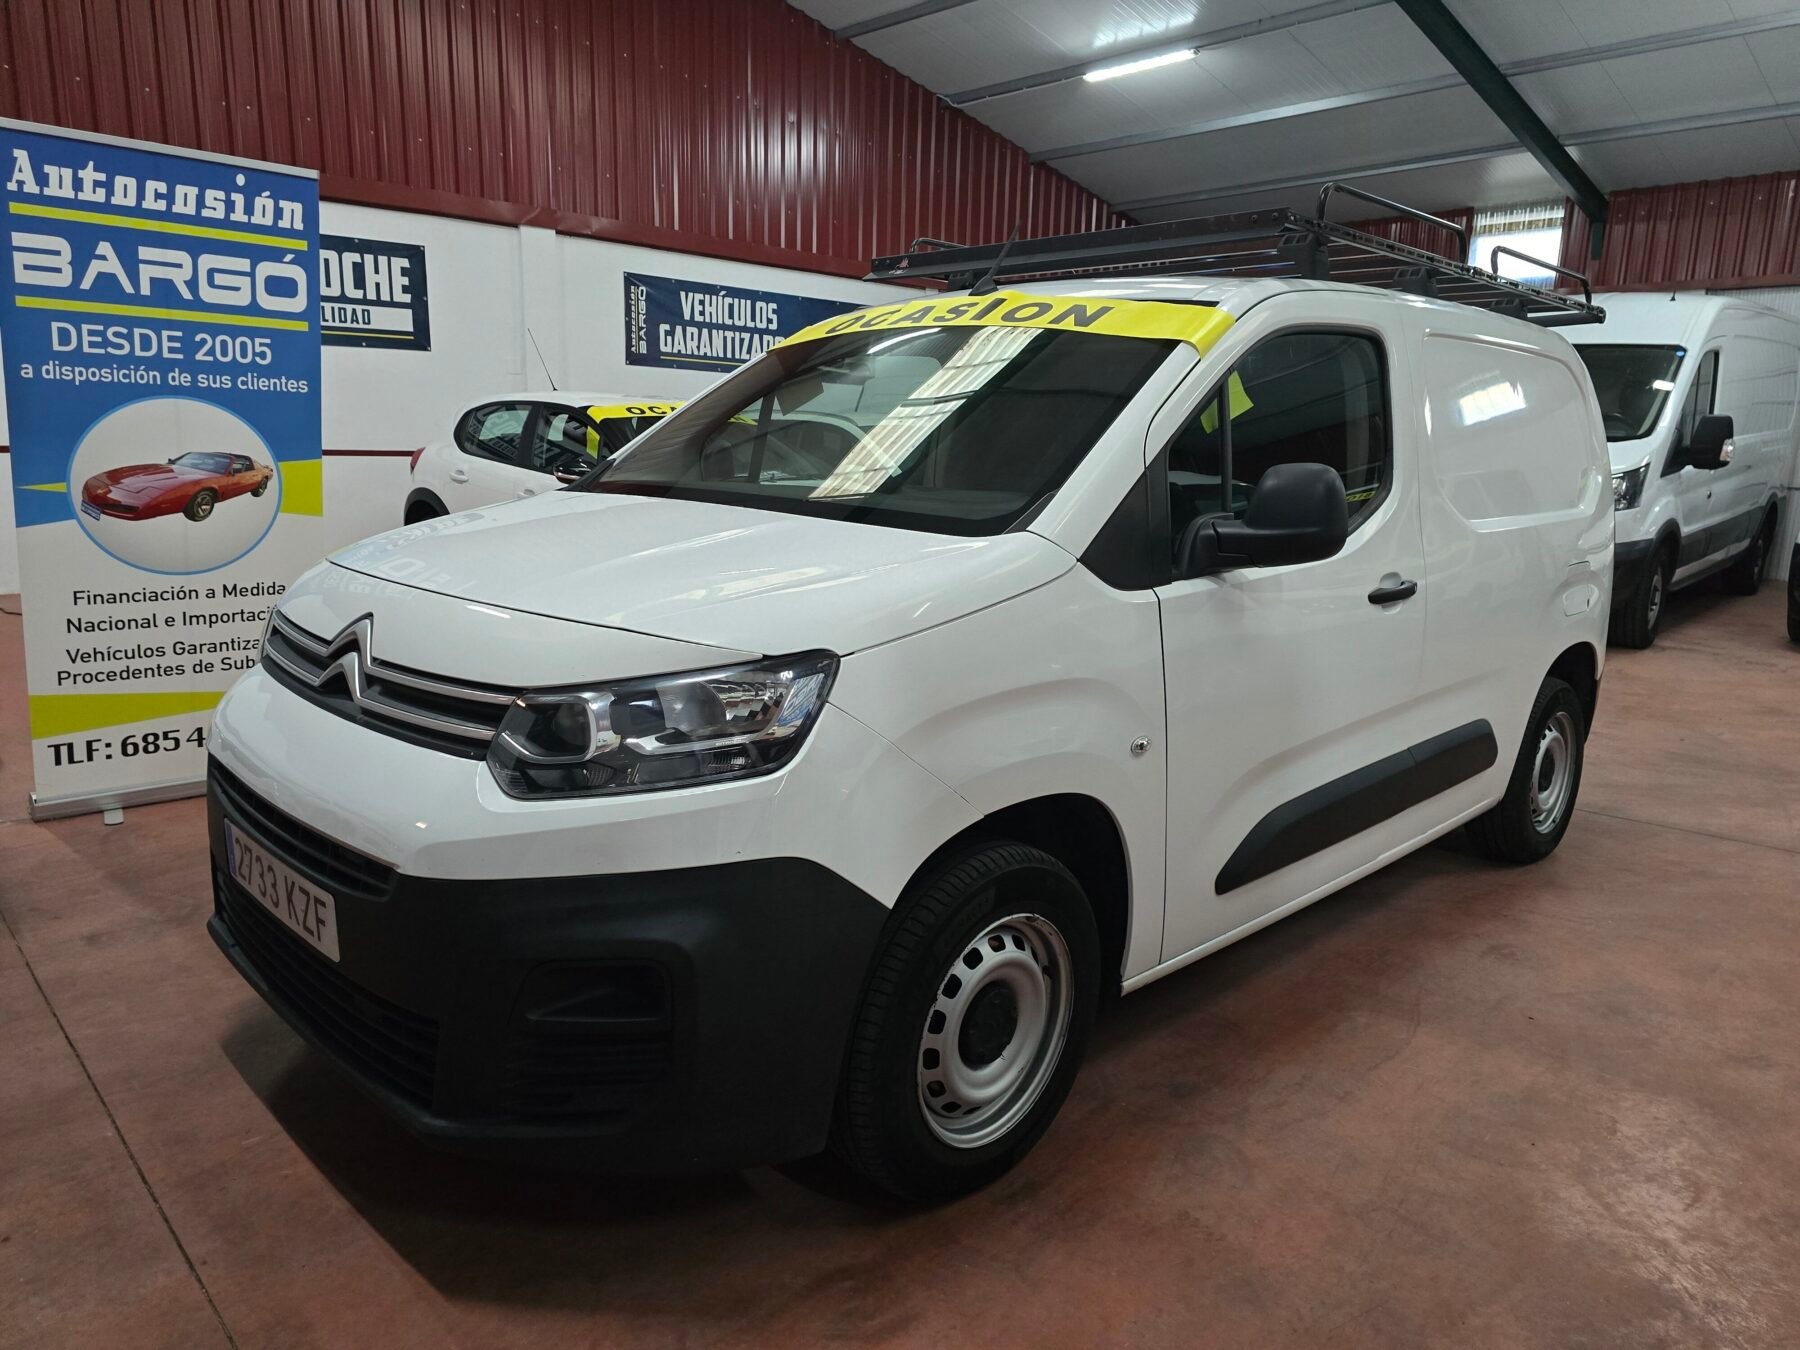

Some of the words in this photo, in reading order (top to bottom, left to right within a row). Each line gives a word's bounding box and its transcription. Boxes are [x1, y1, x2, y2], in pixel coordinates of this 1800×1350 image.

[7, 148, 303, 231] Autocasión
[11, 232, 308, 313] BARGÓ
[679, 291, 778, 330] VEHÍCULOS
[825, 297, 1115, 336] OCASION
[51, 321, 184, 359] DESDE
[194, 333, 272, 365] 2005
[20, 363, 33, 378] a
[41, 360, 161, 386] disposición
[168, 368, 191, 386] de
[198, 373, 232, 389] sus
[237, 372, 309, 393] clientes
[73, 586, 199, 606] Financiación
[205, 588, 215, 599] a
[222, 581, 286, 599] Medida
[66, 613, 158, 634] Nacional
[164, 616, 176, 627] e
[66, 643, 166, 664] Vehículos
[172, 637, 260, 656] Garantiza
[57, 664, 186, 686] Procedentes
[192, 659, 214, 674] de
[47, 738, 113, 766] TLF:
[235, 837, 279, 909] 2733
[284, 875, 327, 942] KZF
